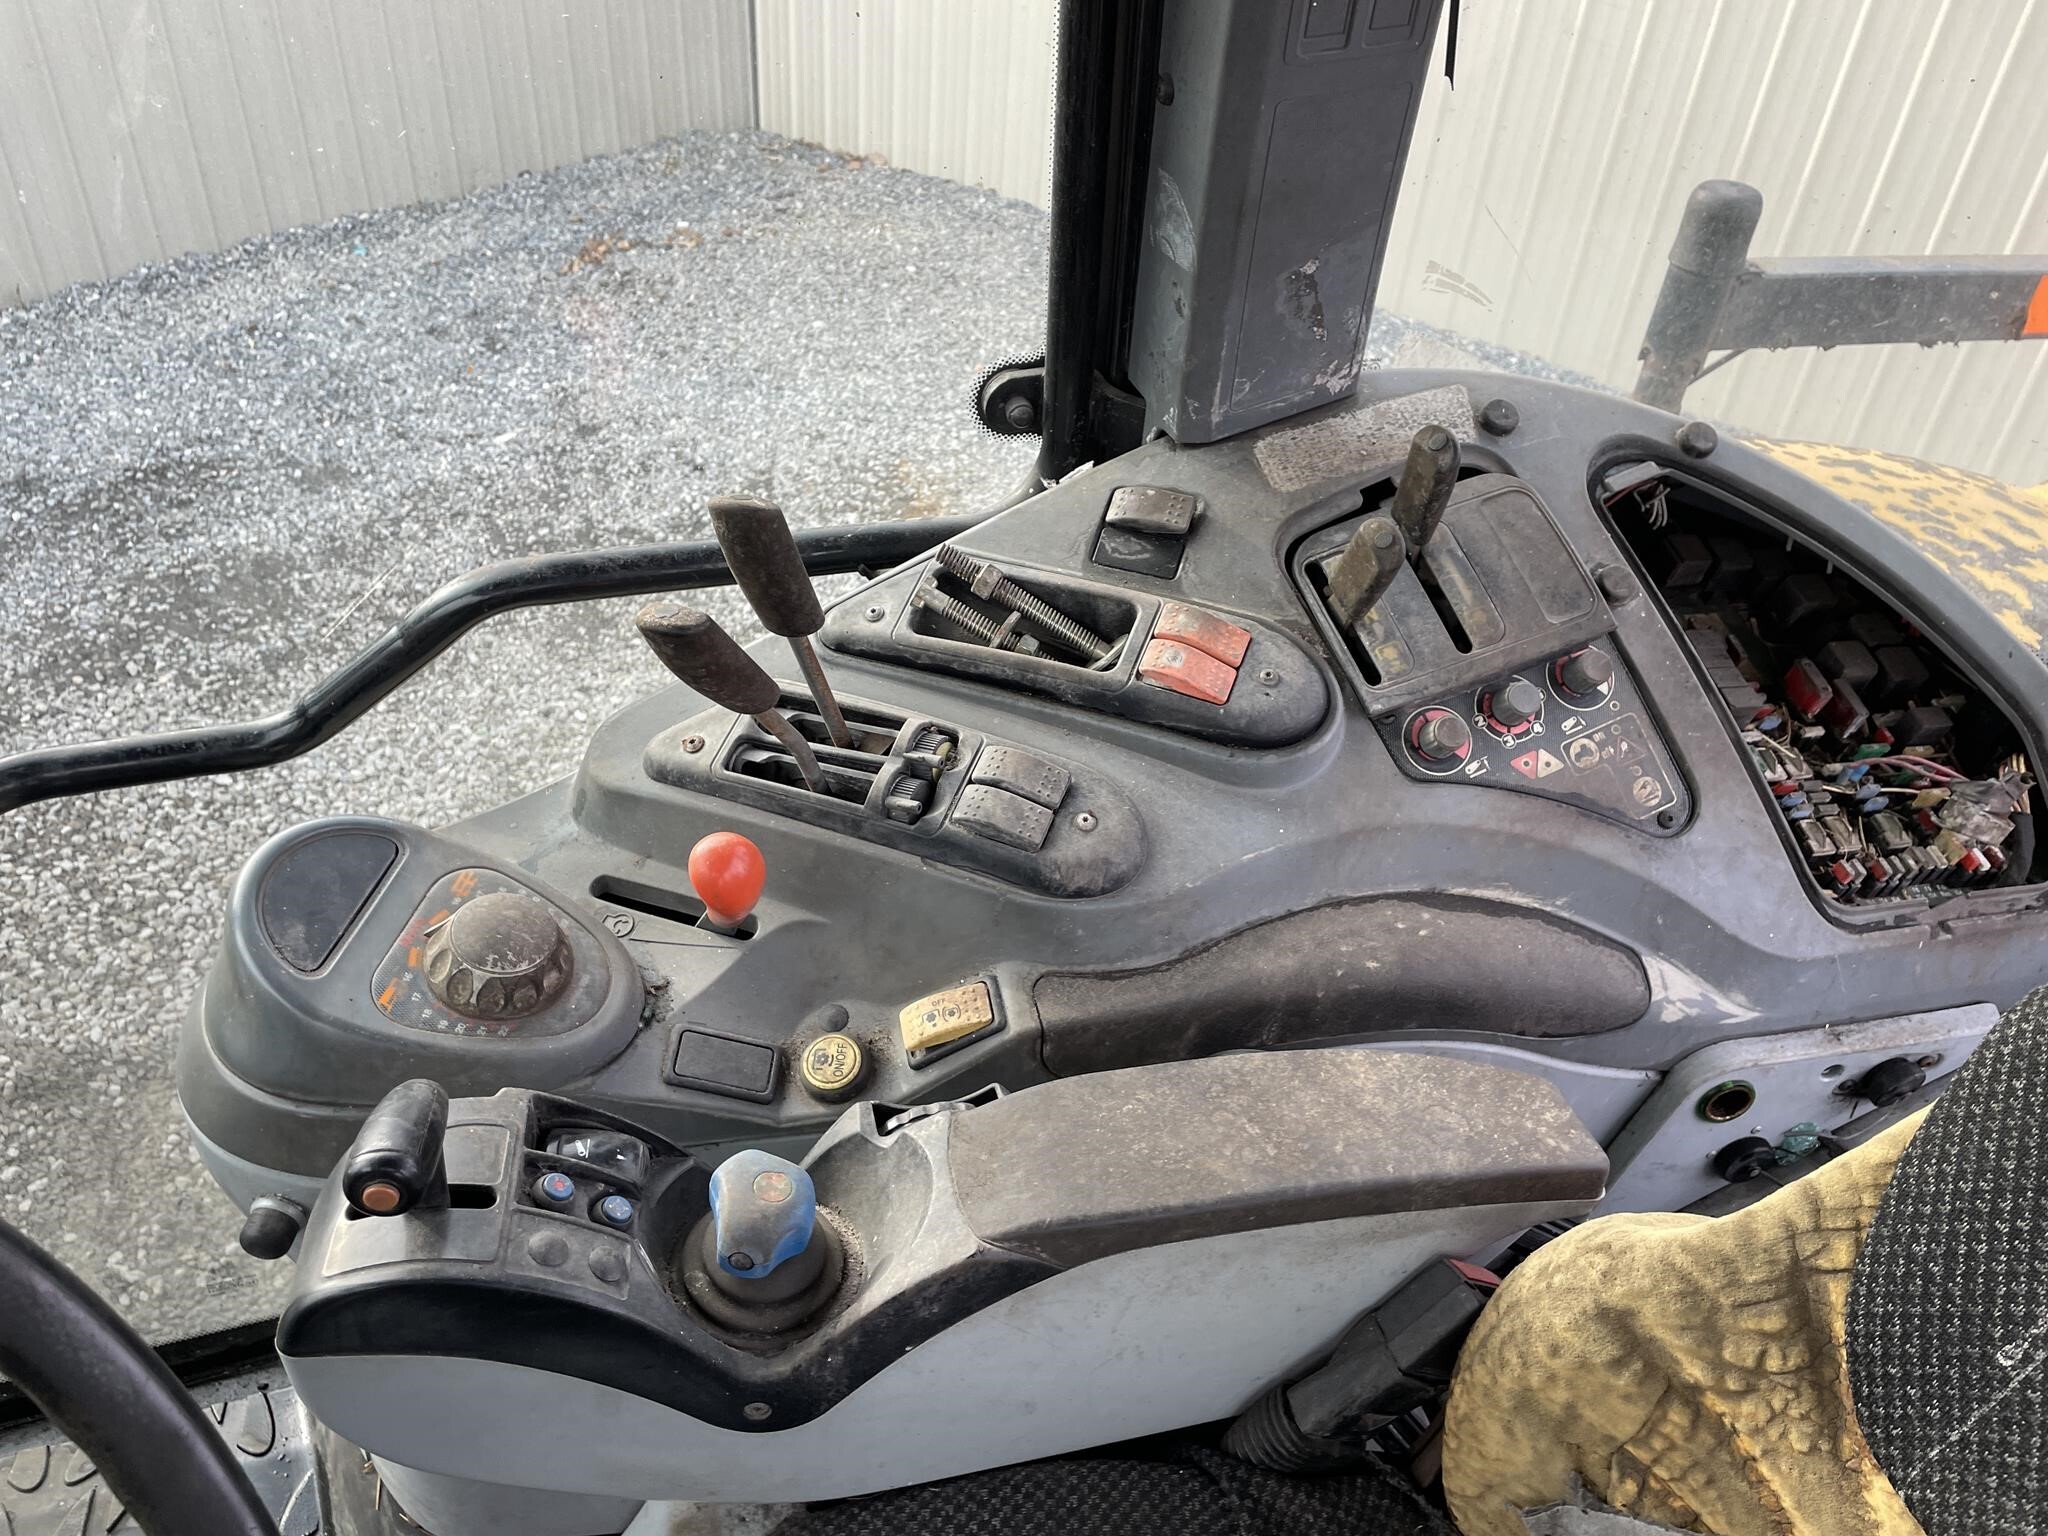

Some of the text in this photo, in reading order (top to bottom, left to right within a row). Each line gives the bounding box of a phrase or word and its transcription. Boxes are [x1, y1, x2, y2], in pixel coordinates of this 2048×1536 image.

[1474, 715, 1486, 727] 2
[1503, 735, 1515, 747] 3
[411, 991, 422, 1001] 17
[931, 998, 946, 1007] OFF
[422, 1008, 433, 1019] 18
[437, 1019, 449, 1030] 19
[455, 1022, 467, 1034] 20
[832, 1043, 847, 1077] ON/OFF
